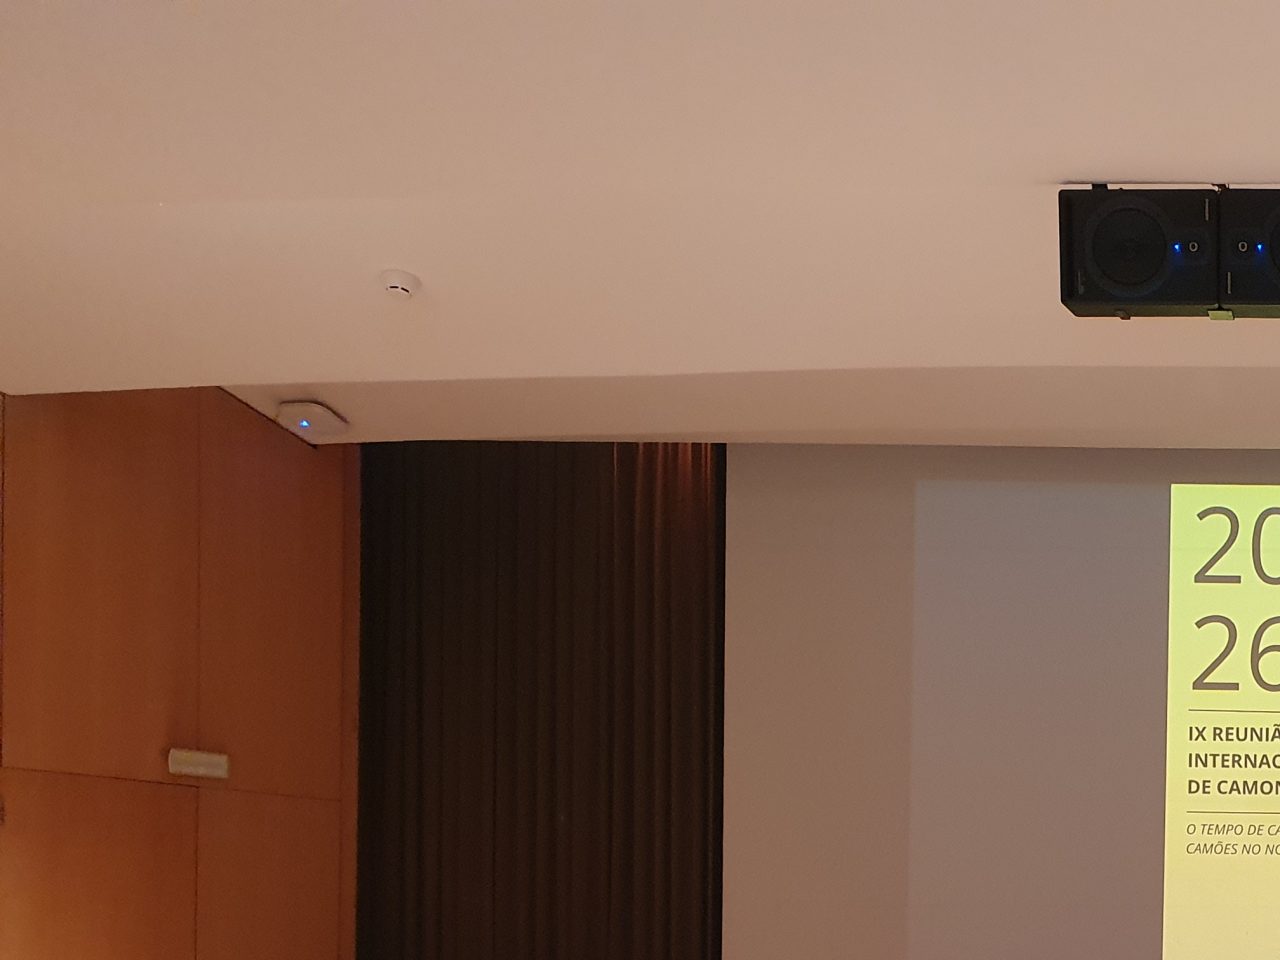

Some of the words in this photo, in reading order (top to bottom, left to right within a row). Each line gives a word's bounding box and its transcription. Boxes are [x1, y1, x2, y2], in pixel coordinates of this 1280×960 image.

[1188, 726, 1207, 742] IX
[1187, 779, 1211, 796] DE
[1186, 823, 1196, 835] O
[1200, 823, 1244, 836] TEMPO
[1247, 824, 1265, 836] DE
[1186, 841, 1238, 855] CAMÕES
[1241, 843, 1261, 855] NO
